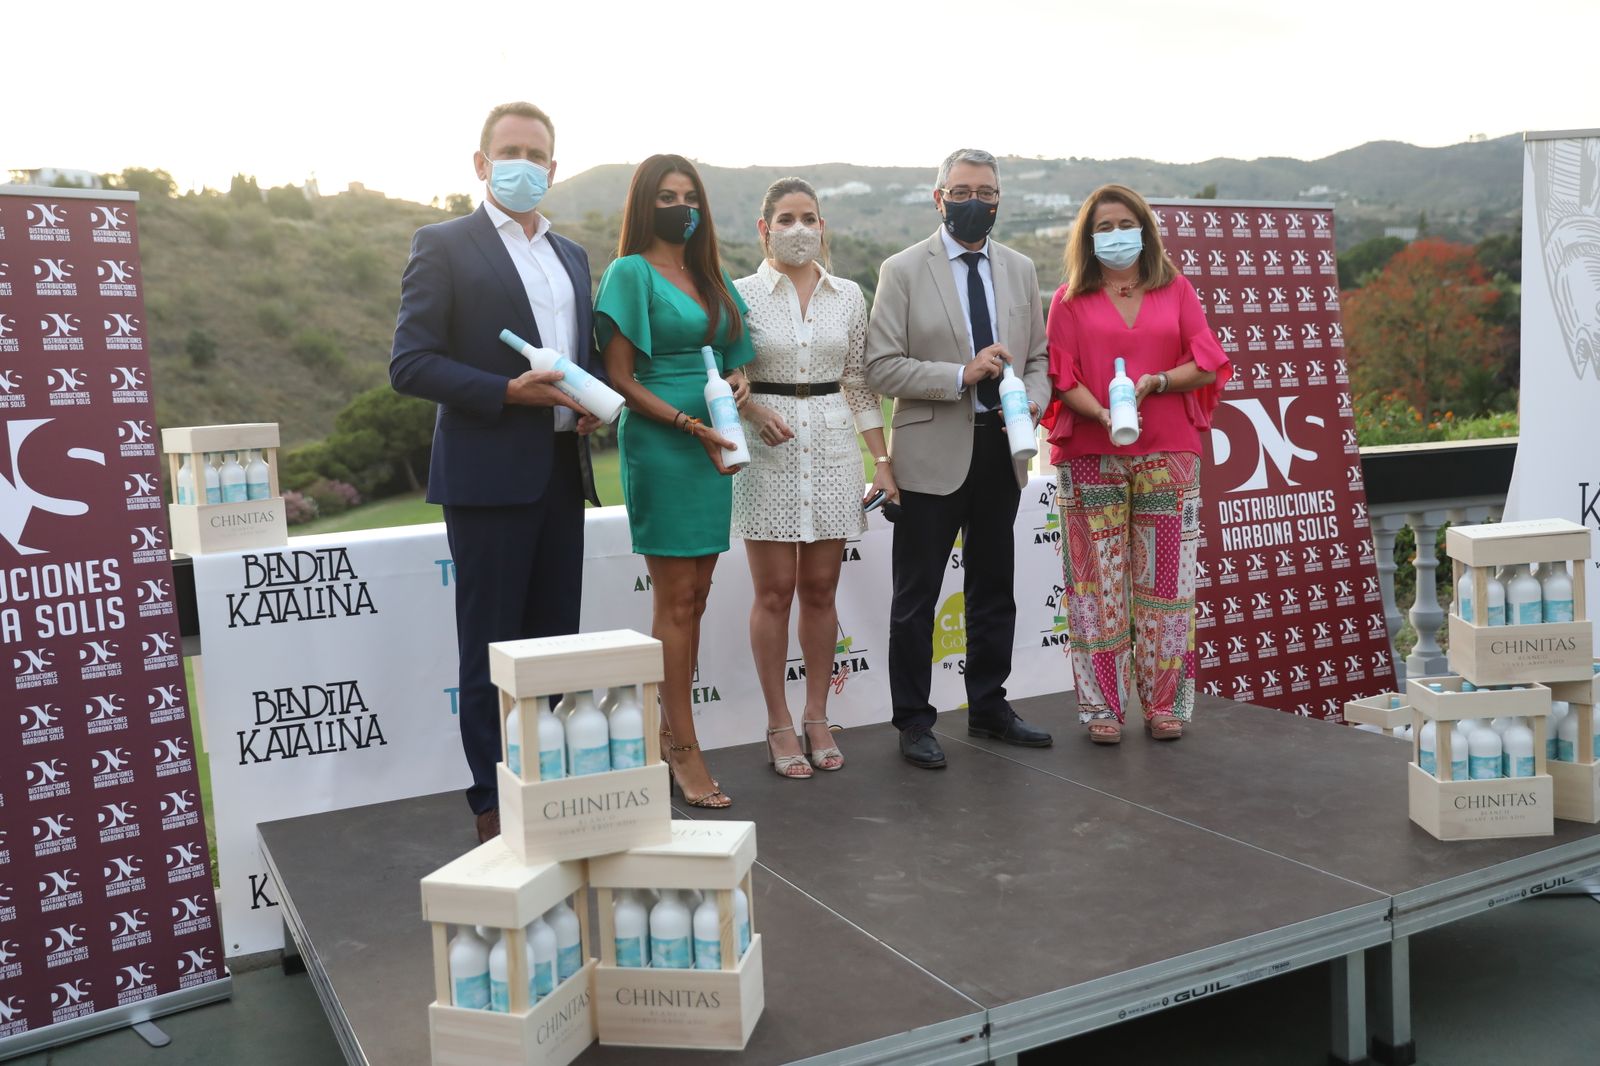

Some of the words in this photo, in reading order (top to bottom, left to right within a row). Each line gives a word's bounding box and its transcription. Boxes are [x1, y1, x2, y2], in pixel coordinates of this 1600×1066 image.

[1219, 490, 1335, 525] DISTRIBUCIONES
[210, 510, 274, 528] CHINITAS
[1222, 520, 1293, 551] NARBONA
[1298, 516, 1338, 542] SOLIS
[242, 548, 357, 589] BENDITA
[226, 582, 378, 628] KATALINA
[36, 596, 126, 638] SOLIS
[1490, 636, 1576, 654] CHINITAS
[81, 663, 121, 673] DISTRIBUCIONES
[16, 672, 57, 683] DISTRIBUCIONES
[252, 680, 368, 725] BENDITA
[88, 716, 127, 728] DISTRIBUCIONES
[22, 727, 63, 738] DISTRIBUCIONES
[237, 714, 387, 765] KATALINA
[94, 770, 133, 782] DISTRIBUCIONES
[29, 781, 69, 794] DISTRIBUCIONES
[544, 787, 650, 820] CHINITAS
[1454, 792, 1537, 810] CHINITAS
[100, 824, 139, 836] DISTRIBUCIONES
[35, 836, 76, 850] DISTRIBUCIONES
[62, 843, 76, 851] SOLIS
[106, 877, 145, 891] DISTRIBUCIONES
[1530, 876, 1574, 894] GUIL
[41, 891, 82, 906] DISTRIBUCIONES
[68, 898, 82, 906] SOLIS
[174, 916, 210, 930] DISTRIBUCIONES
[112, 931, 151, 945] DISTRIBUCIONES
[138, 937, 151, 945] SOLIS
[47, 946, 88, 961] DISTRIBUCIONES
[74, 952, 88, 961] SOLIS
[616, 987, 721, 1008] CHINITAS
[1174, 982, 1231, 1003] GUIL
